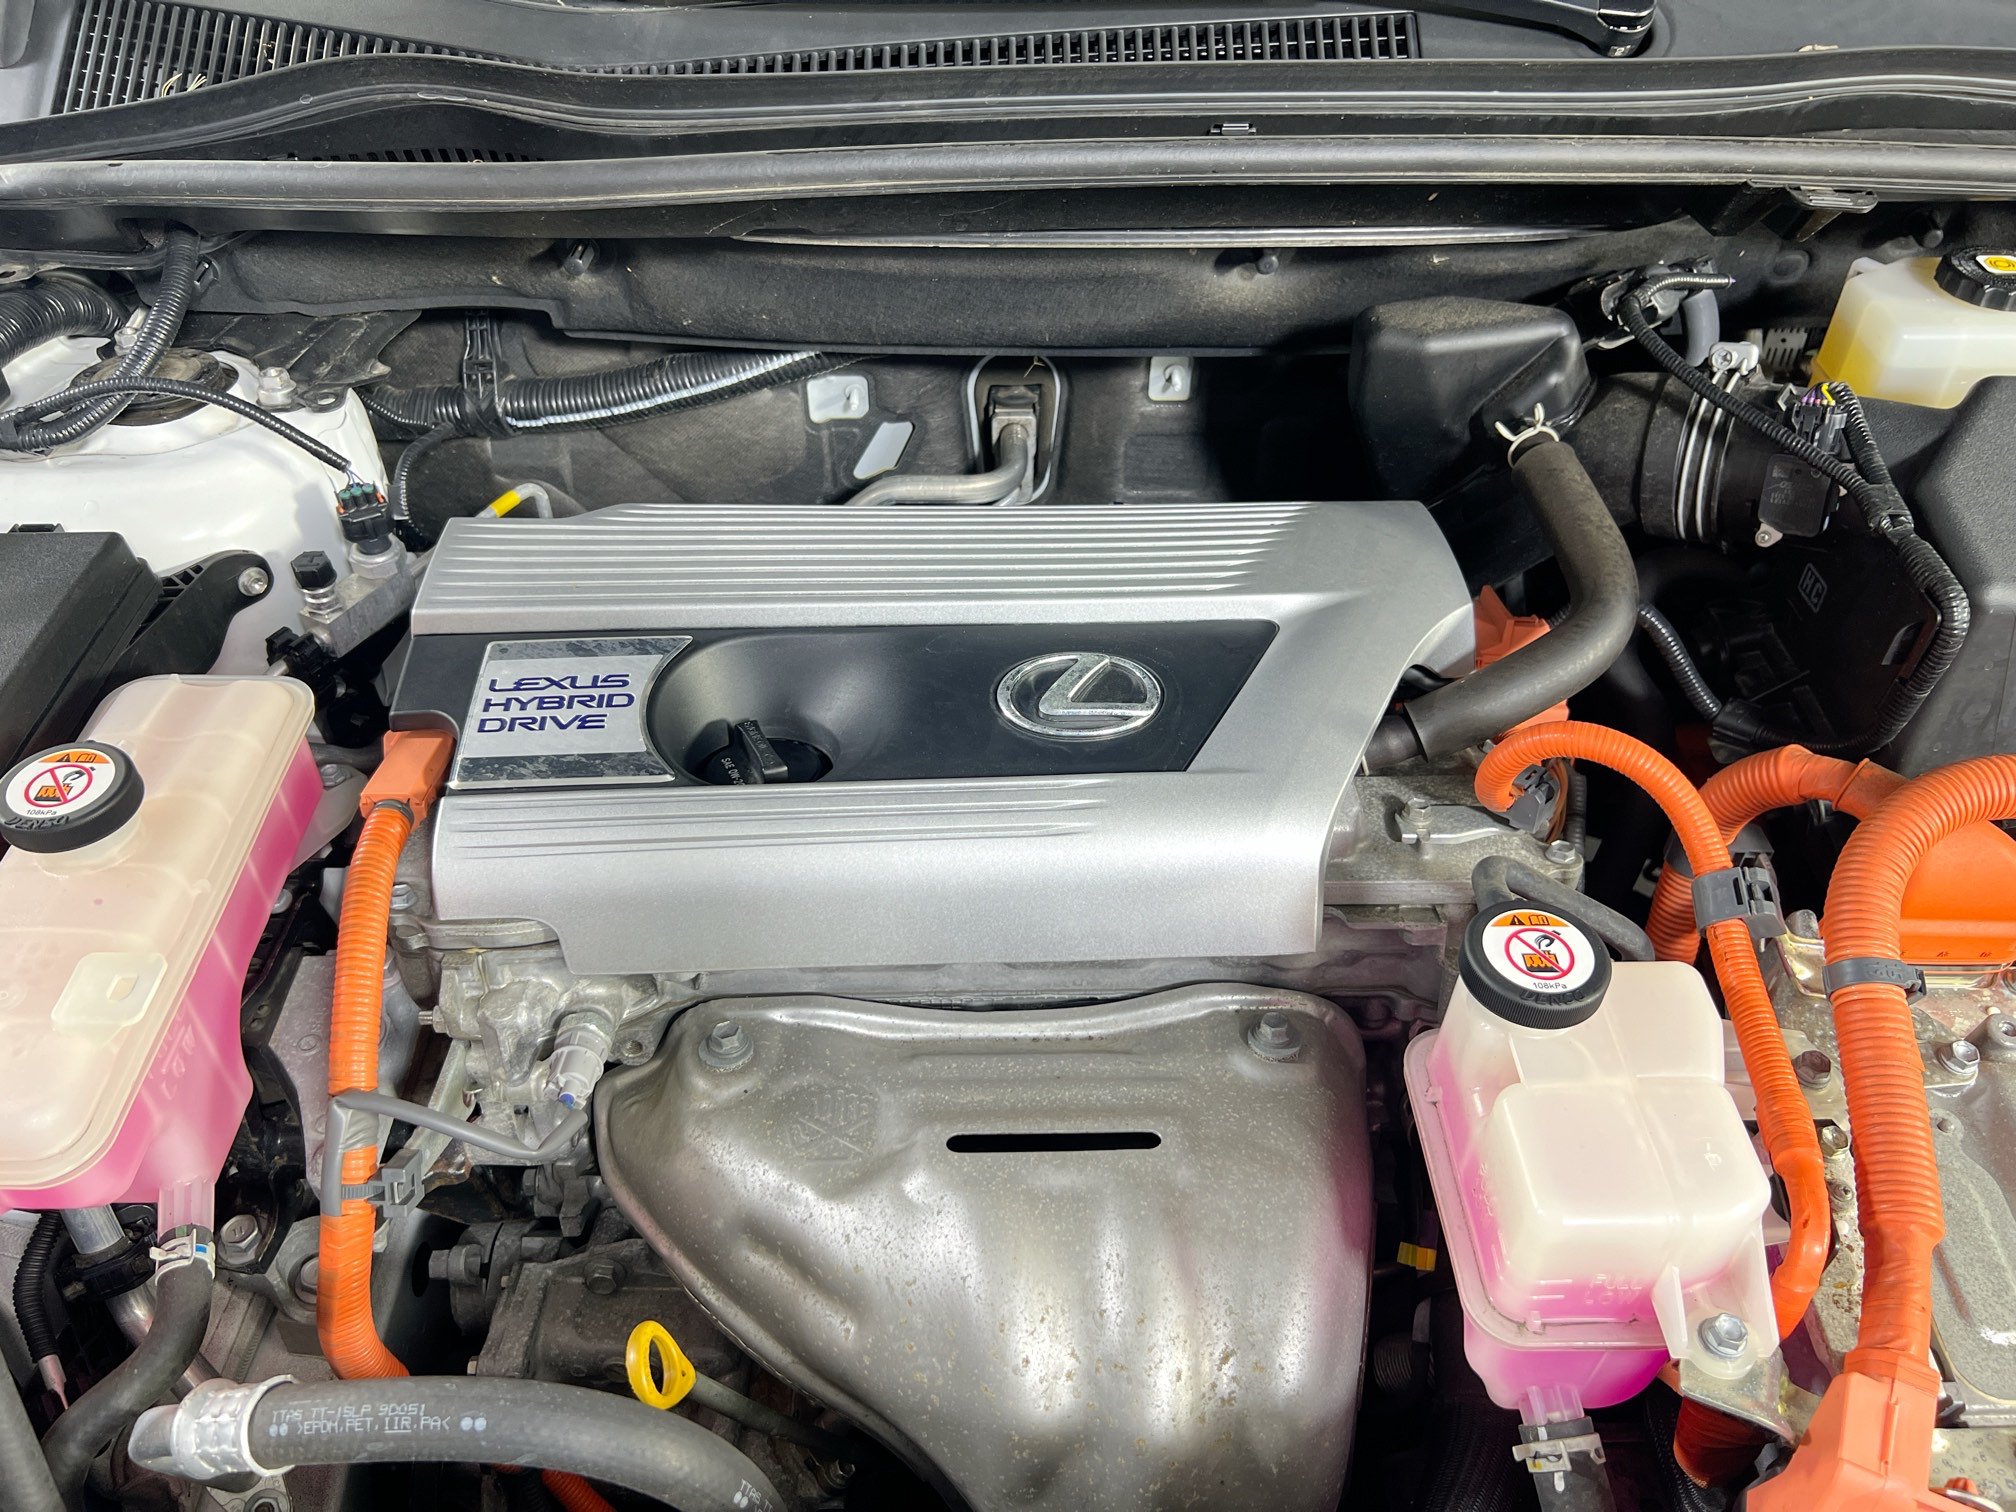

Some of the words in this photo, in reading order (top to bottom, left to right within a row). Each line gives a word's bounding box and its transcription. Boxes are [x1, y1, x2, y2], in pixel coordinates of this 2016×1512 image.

[488, 673, 632, 692] LEXUS
[482, 693, 636, 712] HYBRID
[477, 713, 608, 733] DRIVE
[721, 757, 735, 770] SAE
[4, 815, 71, 830] DENSO
[1532, 982, 1568, 990] 108kPa
[1518, 989, 1585, 1005] DENSO
[1591, 1273, 1643, 1289] FULL
[1584, 1289, 1639, 1304] LOW
